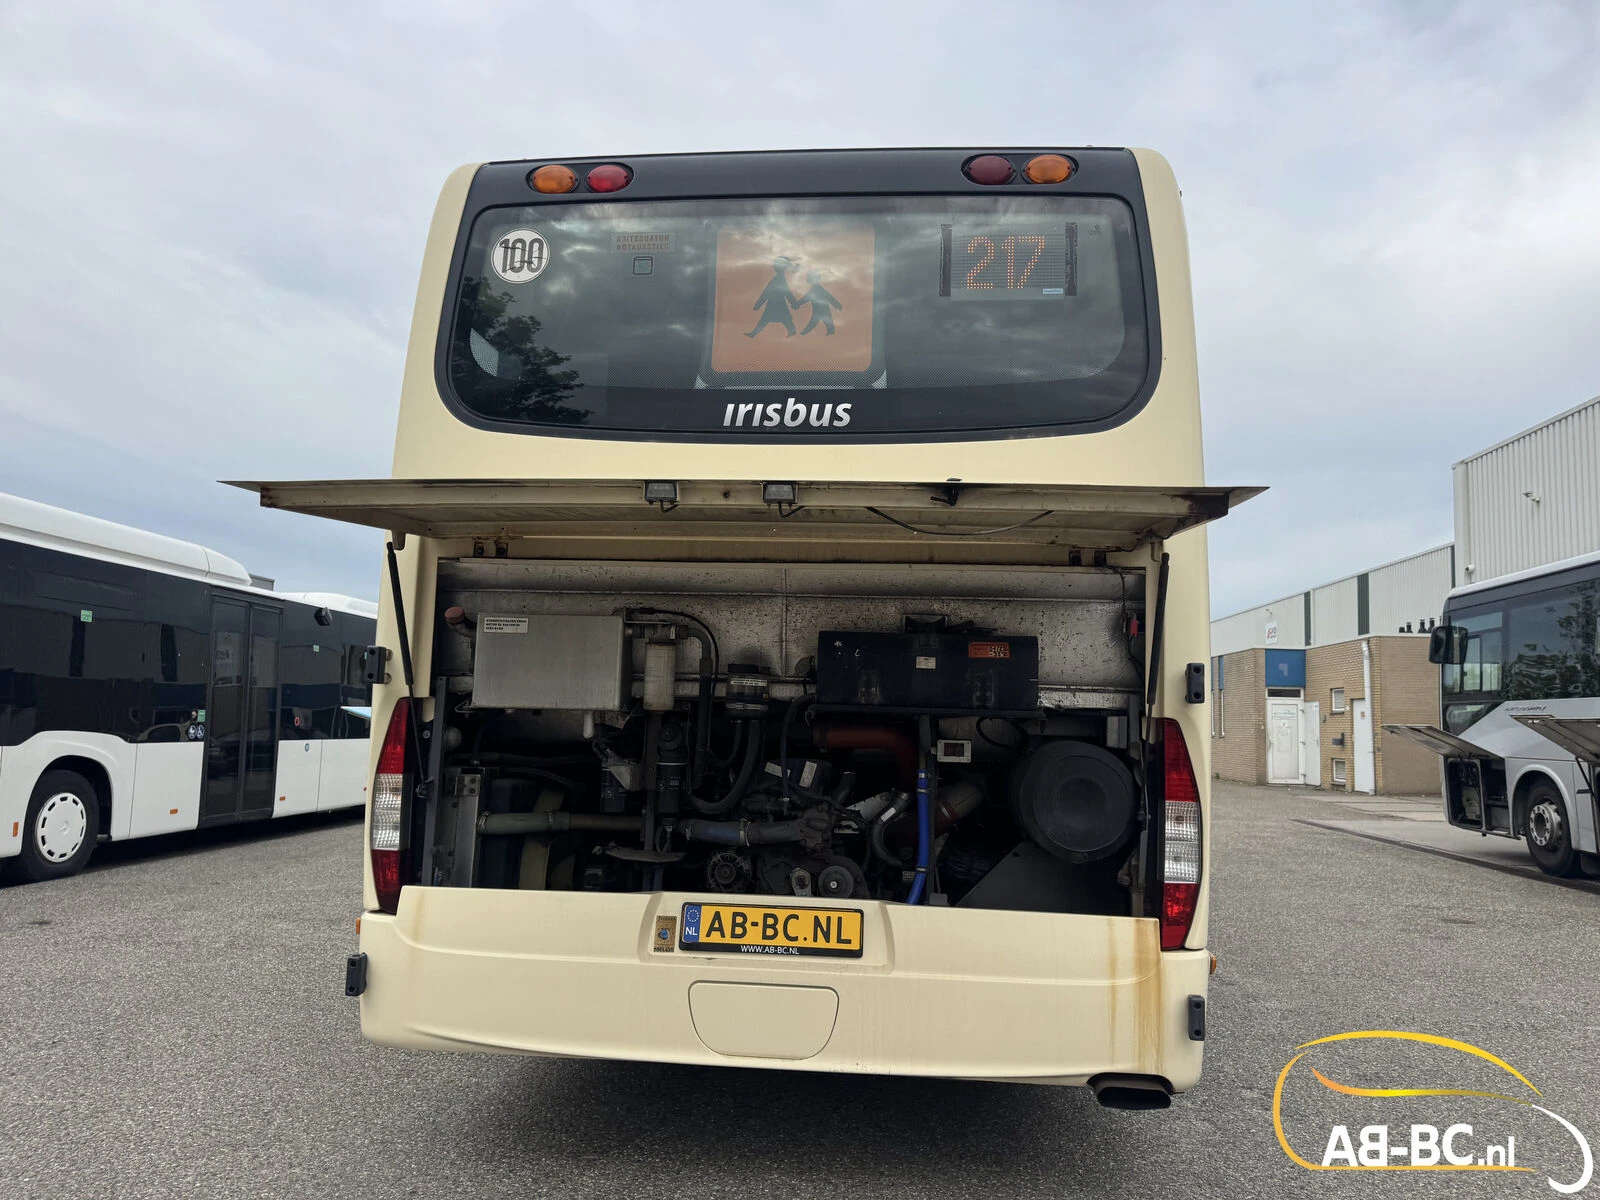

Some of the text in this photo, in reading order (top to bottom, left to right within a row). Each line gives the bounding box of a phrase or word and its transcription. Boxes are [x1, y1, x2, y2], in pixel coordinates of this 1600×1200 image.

[499, 238, 544, 273] 100
[967, 236, 1046, 289] 217
[723, 398, 852, 427] irisbus
[685, 926, 698, 936] NL
[705, 911, 852, 944] AB-BC.NL
[740, 945, 800, 955] WWW.AB-BC.NL
